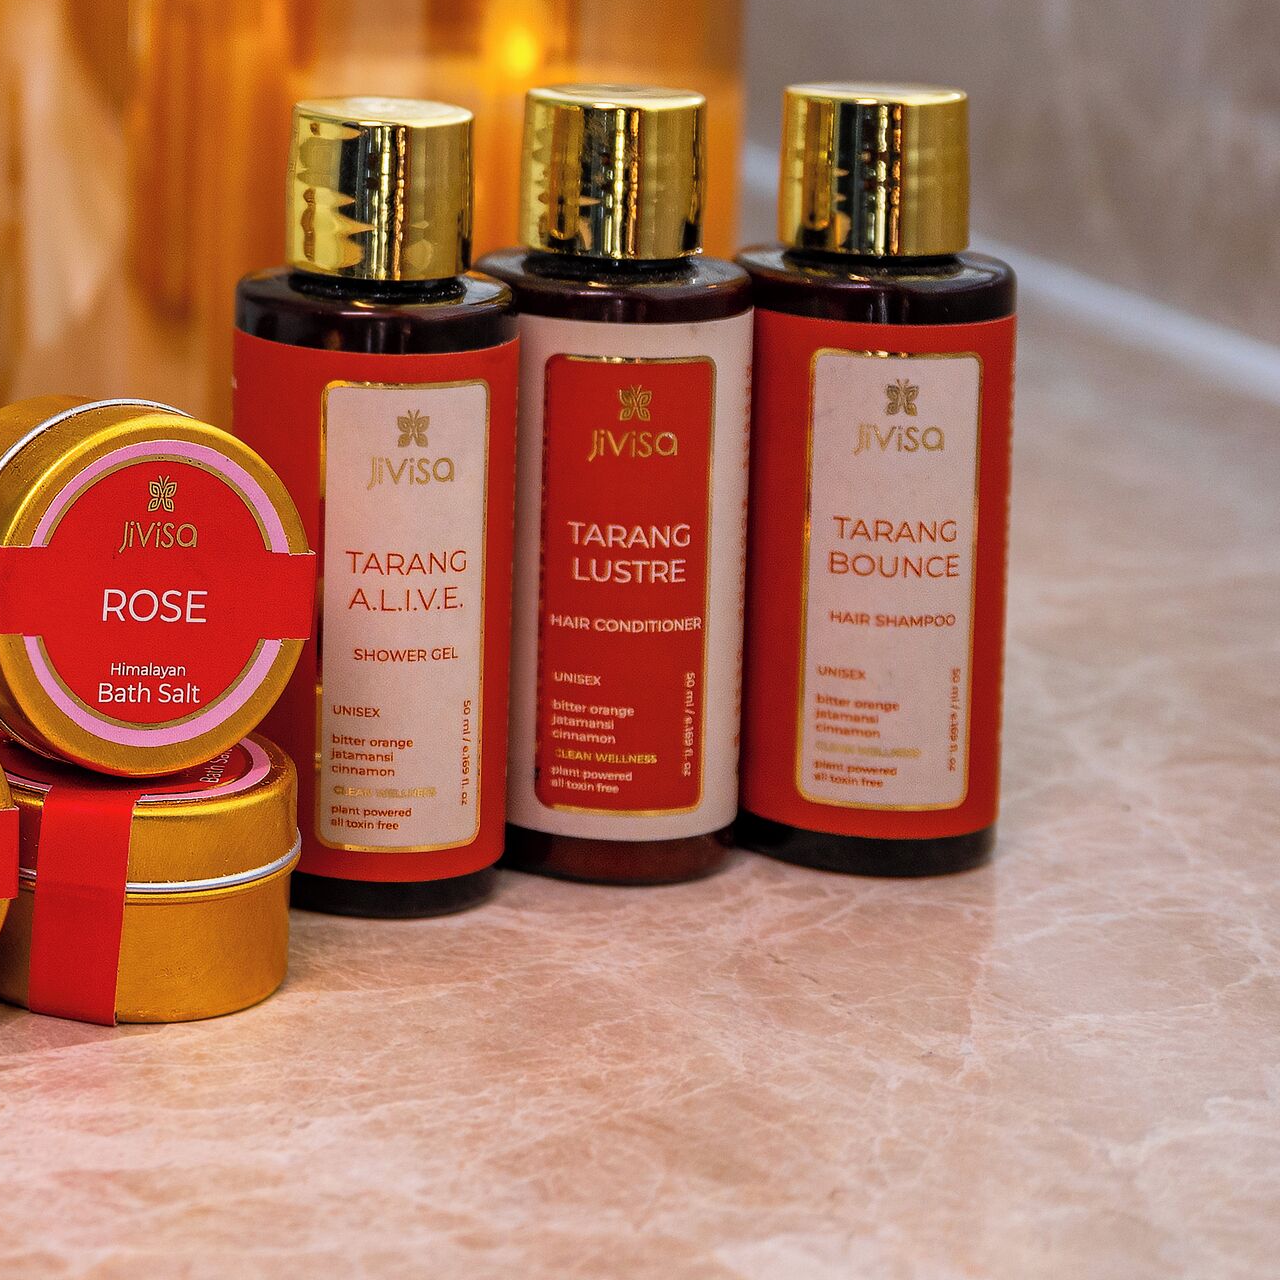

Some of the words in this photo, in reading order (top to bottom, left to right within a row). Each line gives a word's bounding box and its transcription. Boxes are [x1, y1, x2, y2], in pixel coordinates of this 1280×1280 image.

[567, 521, 690, 549] TARANG
[833, 515, 958, 543] TARANG
[345, 550, 467, 576] TARANG
[572, 557, 686, 584] LUSTRE
[828, 551, 960, 578] BOUNCE
[102, 589, 208, 624] ROSE
[348, 586, 464, 612] A.L.I.V.E.
[551, 613, 590, 630] HAIR
[594, 616, 702, 633] CONDITIONER
[829, 610, 870, 626] HAIR
[875, 613, 956, 628] SHAMPOO
[354, 648, 427, 662] SHOWER
[432, 647, 458, 661] GEL
[110, 662, 186, 679] Himalayan
[818, 665, 866, 680] UNISEX
[554, 672, 601, 686] UNISEX
[98, 683, 151, 704] Bath
[158, 683, 200, 705] Salt
[333, 705, 381, 718] UNISEX
[463, 699, 471, 715] 50
[552, 699, 586, 713] bitter
[590, 705, 634, 718] orange
[462, 720, 471, 735] ml
[552, 716, 614, 729] jatamansi
[332, 734, 366, 747] bitter
[370, 738, 413, 750] orange
[552, 729, 616, 744] cinnamon
[210, 749, 233, 764] Sa
[331, 748, 394, 762] jatamansi
[555, 748, 591, 761] CLEAN
[596, 753, 657, 764] WELLNESS
[331, 765, 395, 777] cinnamon
[551, 766, 580, 777] plant
[583, 770, 632, 781] powered
[566, 781, 595, 791] toxin
[597, 783, 619, 794] free
[461, 792, 468, 806] oz
[331, 805, 360, 816] plant
[363, 808, 412, 818] powered
[331, 818, 343, 827] all
[346, 820, 374, 830] toxin
[378, 820, 399, 830] free
